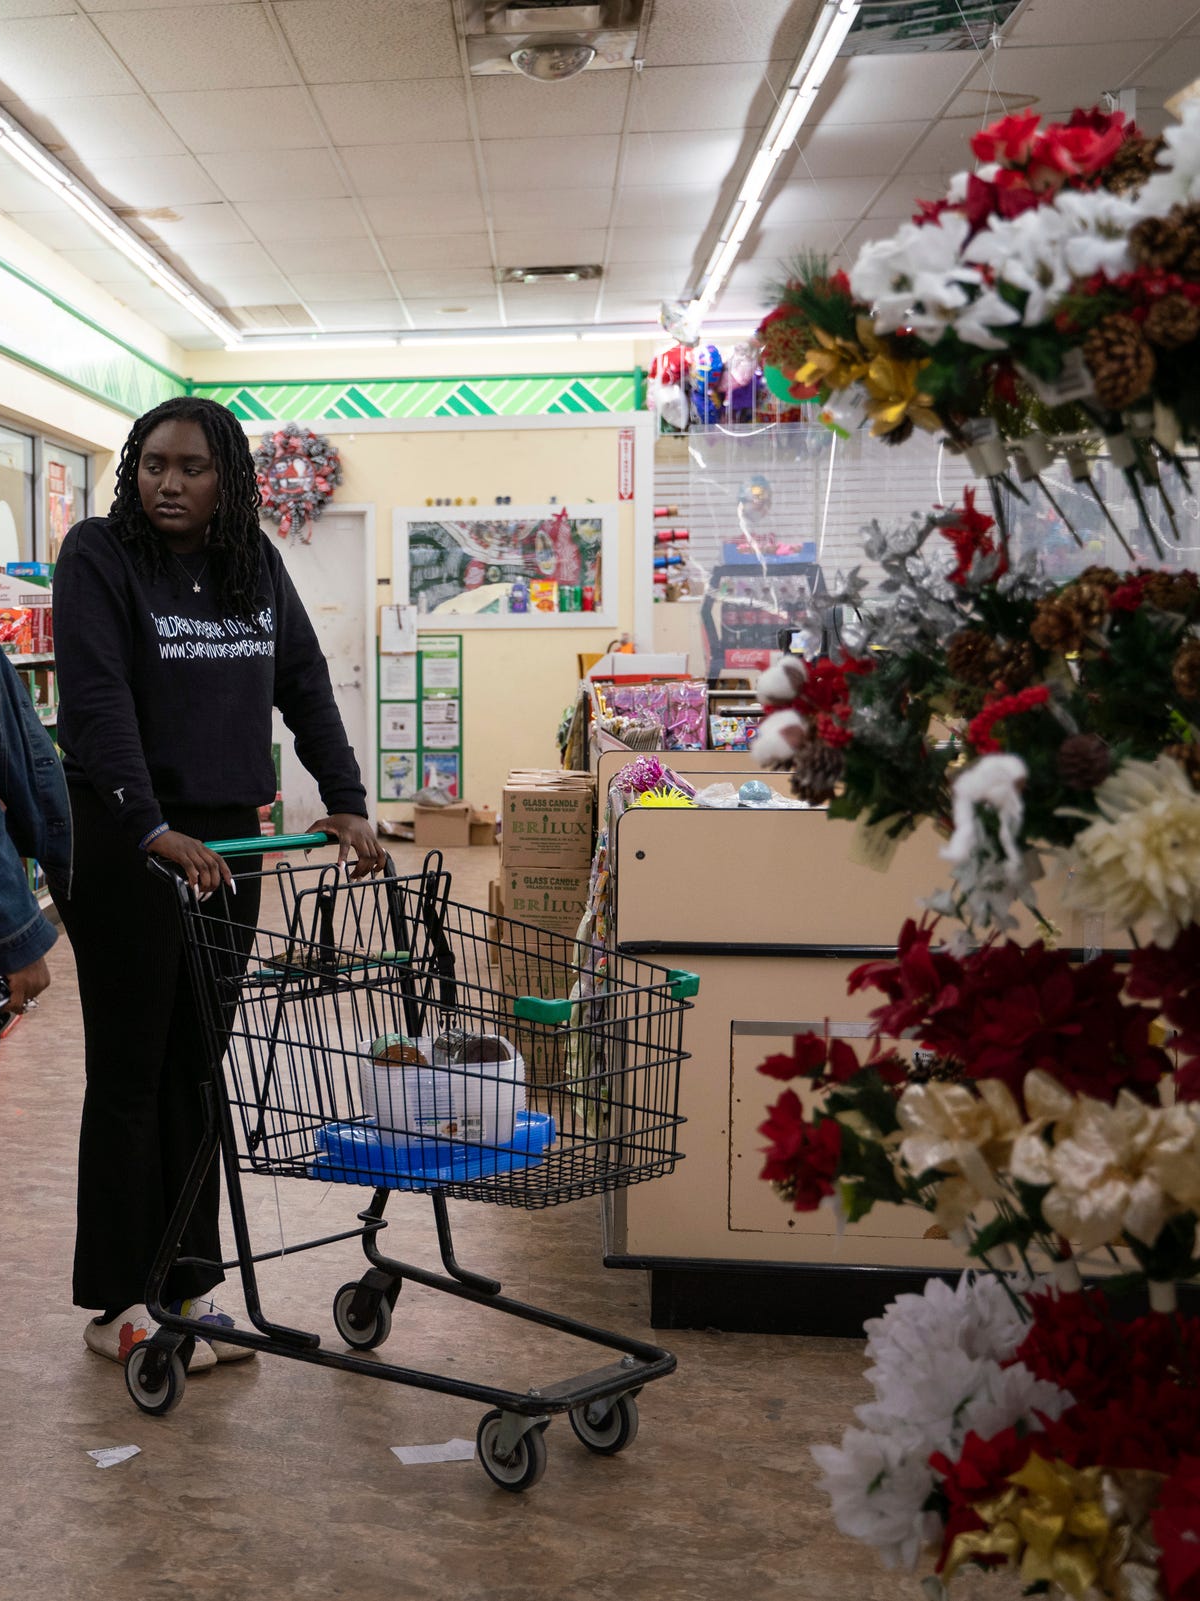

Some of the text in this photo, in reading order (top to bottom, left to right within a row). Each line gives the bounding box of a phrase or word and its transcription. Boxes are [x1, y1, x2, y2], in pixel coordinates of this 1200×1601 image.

[523, 799, 547, 807] GLASS
[523, 876, 579, 887] GLASS CANDLE
